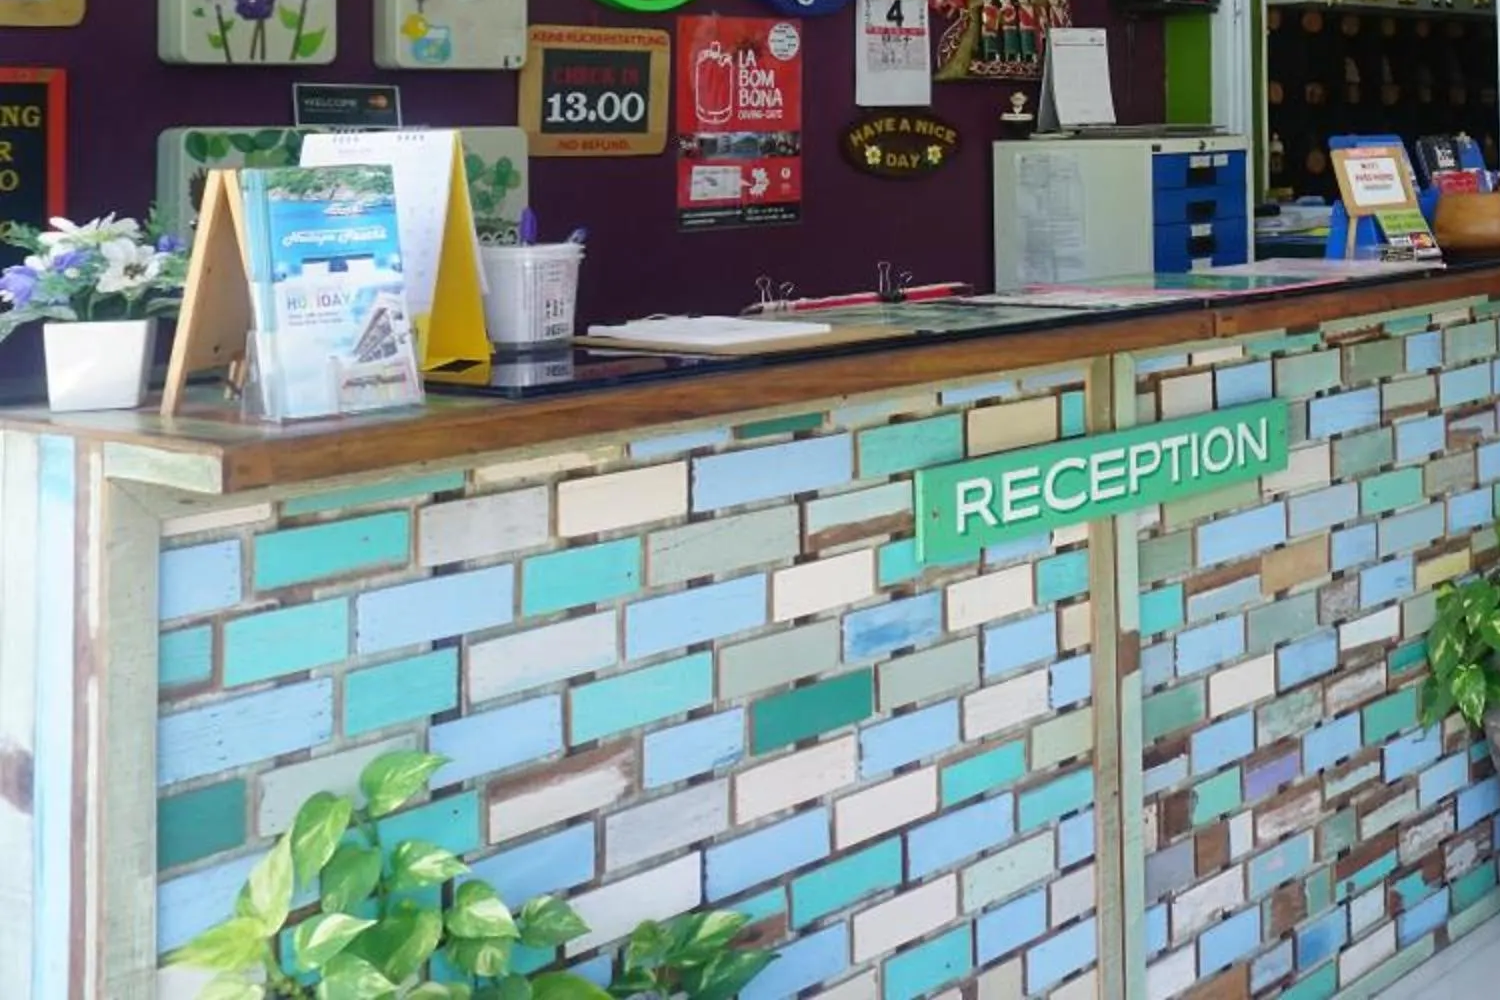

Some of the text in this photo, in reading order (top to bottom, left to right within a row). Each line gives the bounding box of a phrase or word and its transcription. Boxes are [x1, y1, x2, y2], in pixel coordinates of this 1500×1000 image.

[739, 49, 757, 67] LA
[739, 68, 775, 88] BOM
[546, 91, 645, 122] 13.00
[739, 87, 783, 107] BONA
[849, 117, 957, 147] HAVE A NICE
[886, 152, 920, 168] DAY
[956, 417, 1269, 533] RECEPTION
